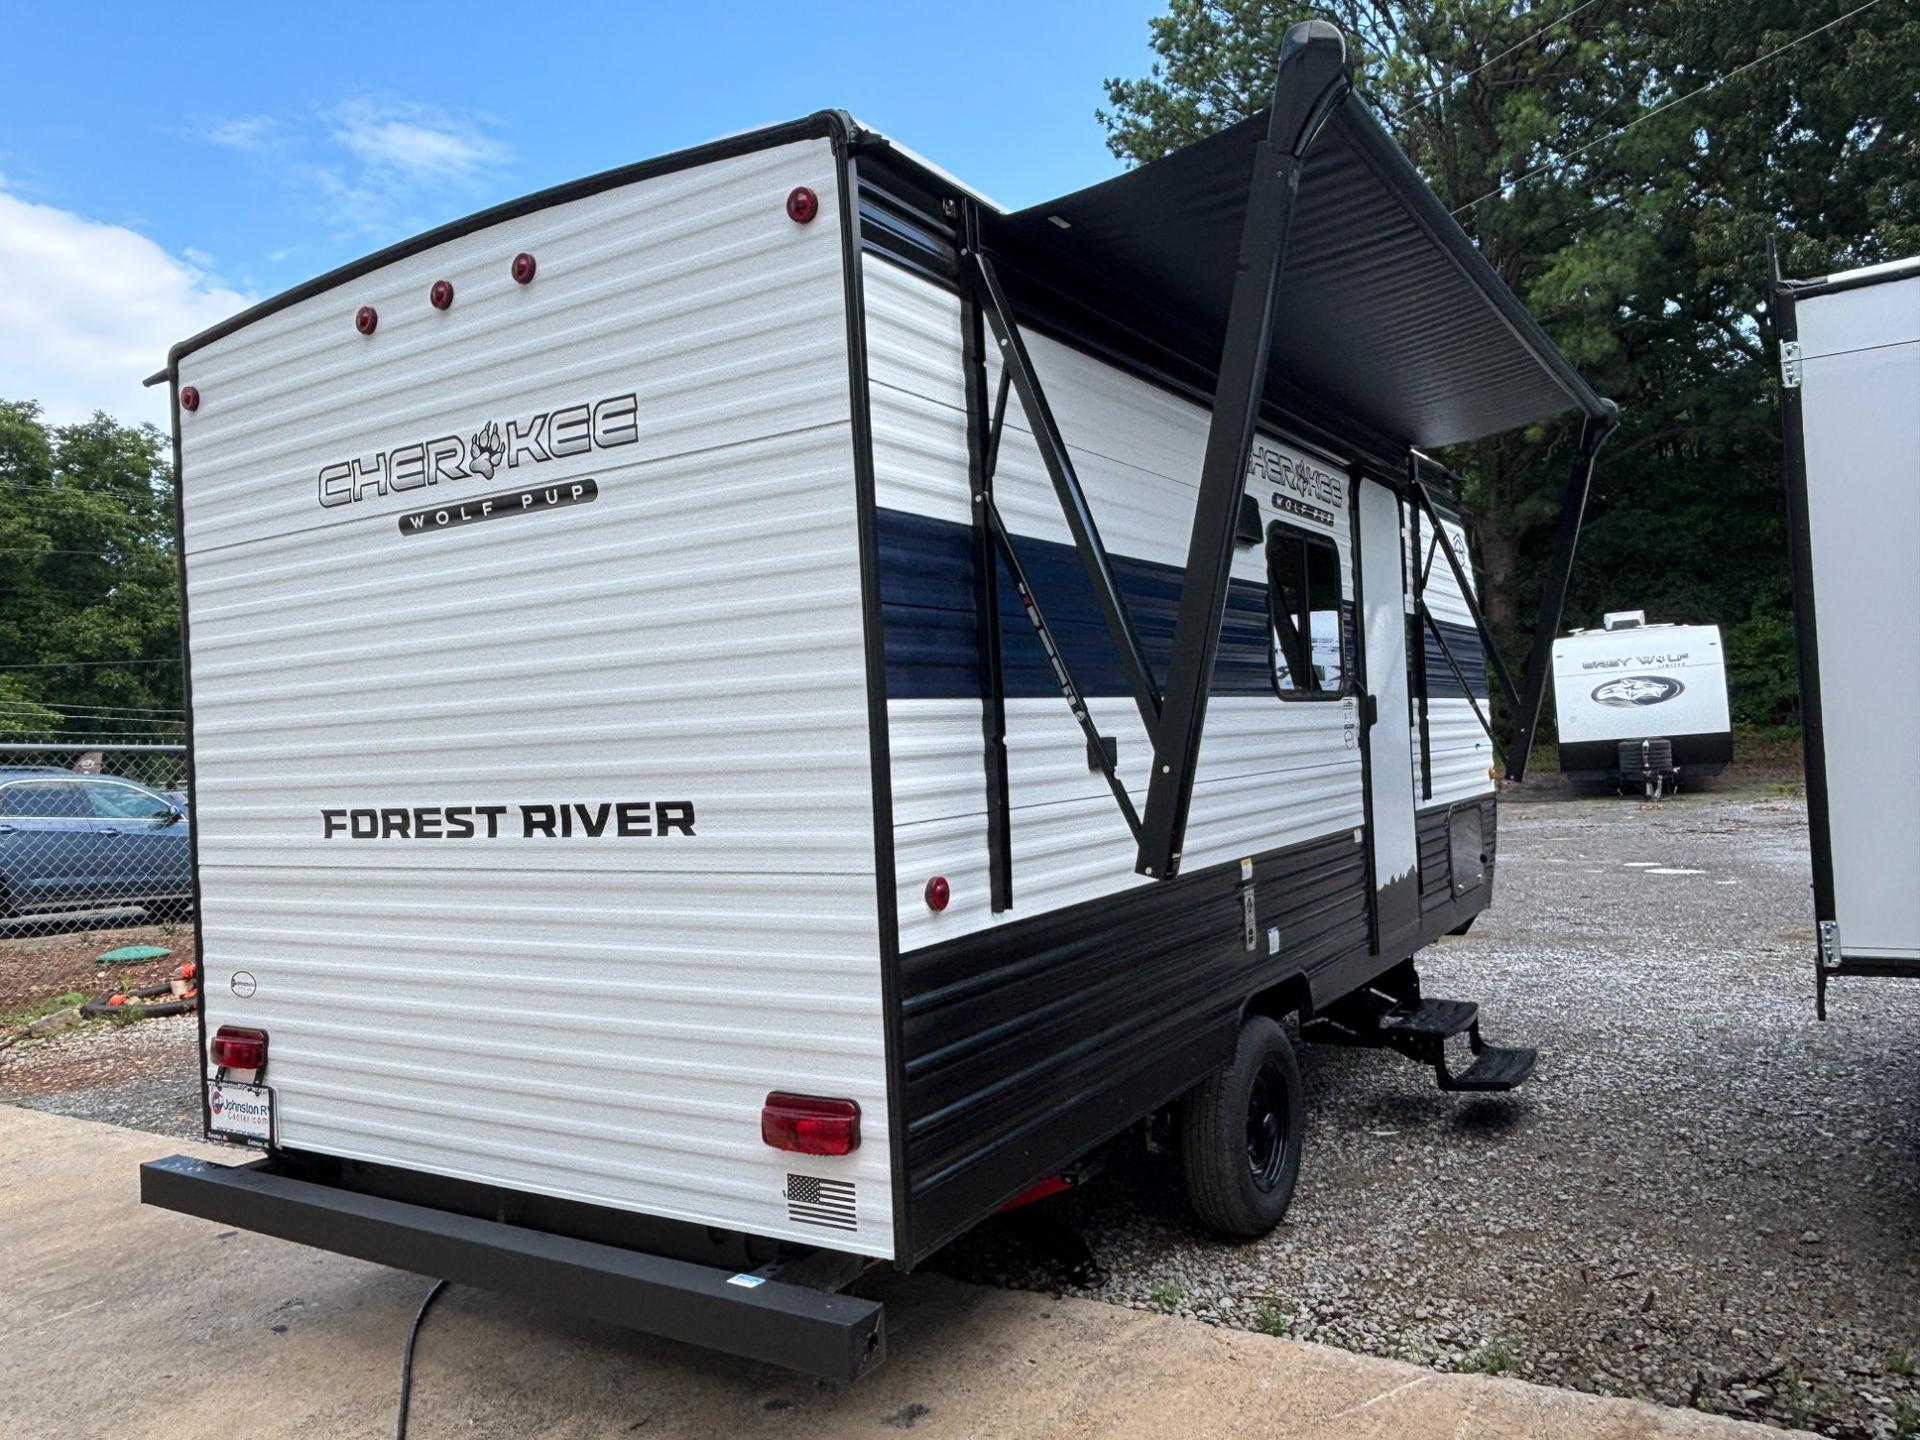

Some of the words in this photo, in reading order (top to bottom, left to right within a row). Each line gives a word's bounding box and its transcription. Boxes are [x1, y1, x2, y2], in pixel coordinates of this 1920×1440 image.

[409, 501, 493, 529] WOLF
[521, 484, 584, 509] PUP
[320, 805, 507, 839] FOREST
[519, 800, 697, 837] RIVER
